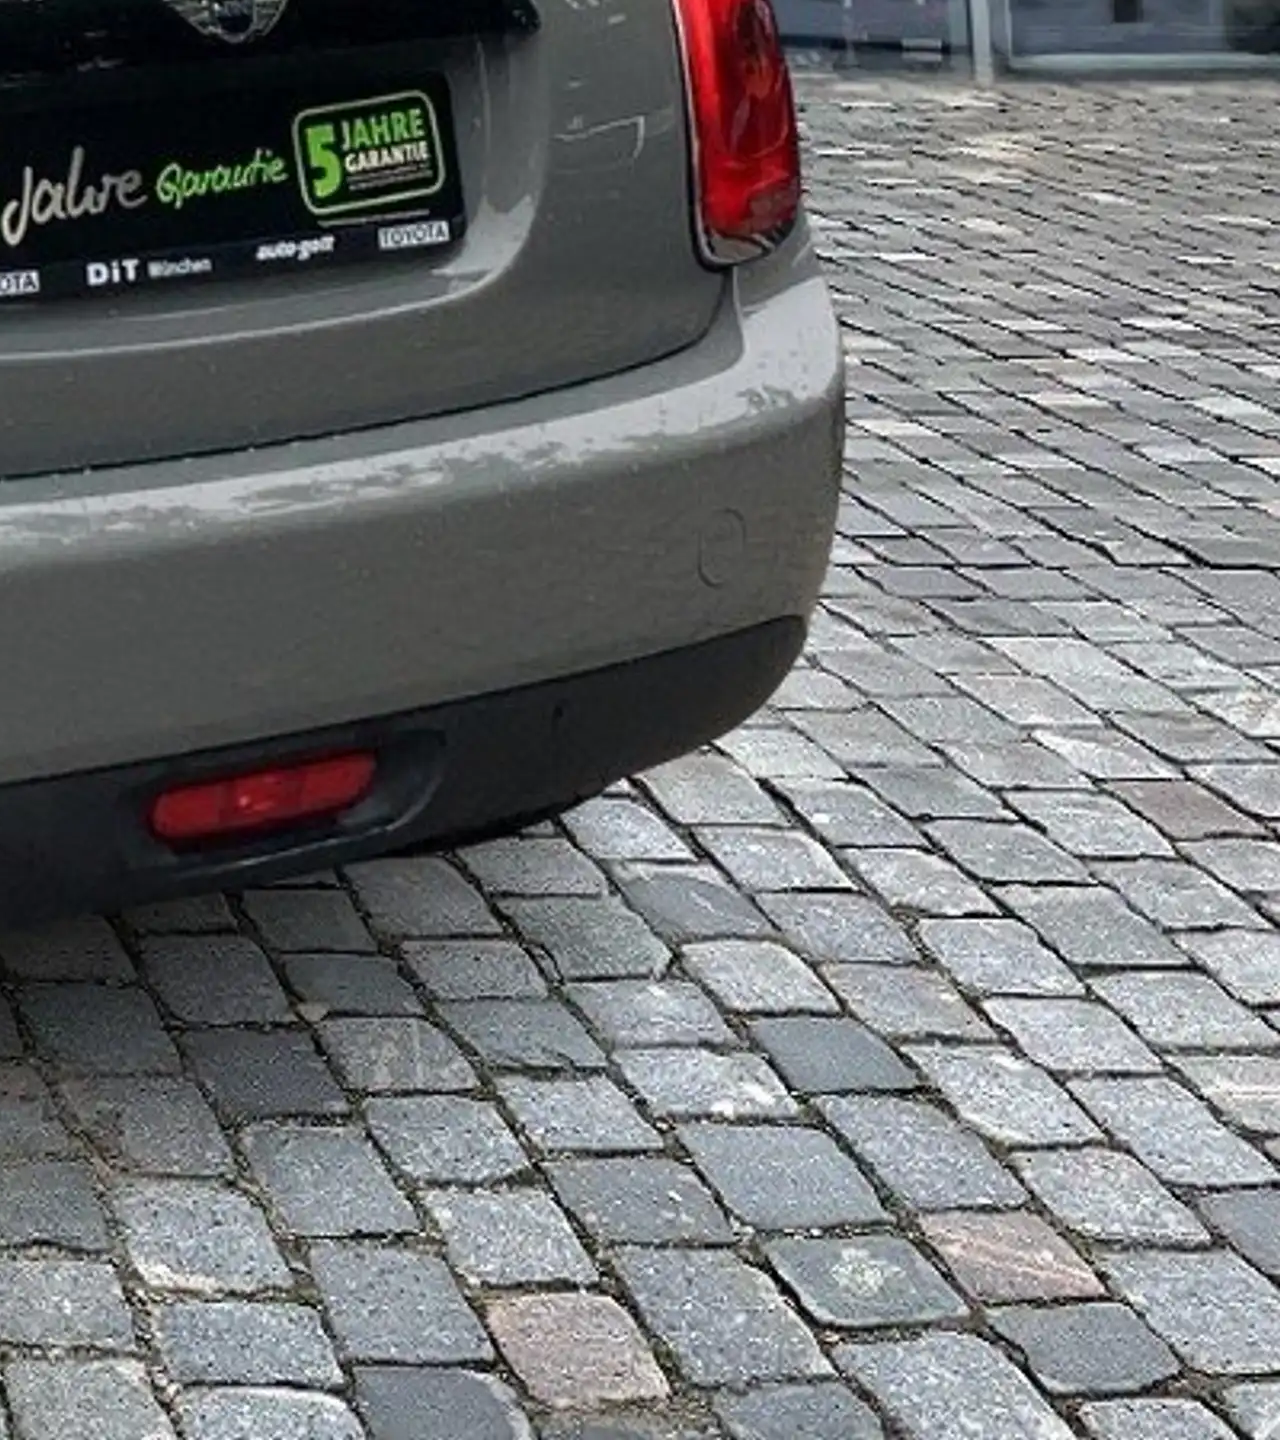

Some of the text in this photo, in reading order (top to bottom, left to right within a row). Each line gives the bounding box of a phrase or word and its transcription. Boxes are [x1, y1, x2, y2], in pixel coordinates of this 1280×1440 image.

[306, 124, 342, 198] 5
[341, 108, 425, 151] JAHRE
[345, 140, 431, 173] GARANTIE
[1, 145, 148, 246] Jahre
[156, 147, 288, 209] Garantie
[380, 221, 450, 250] TOYOTA
[87, 259, 140, 286] DiT
